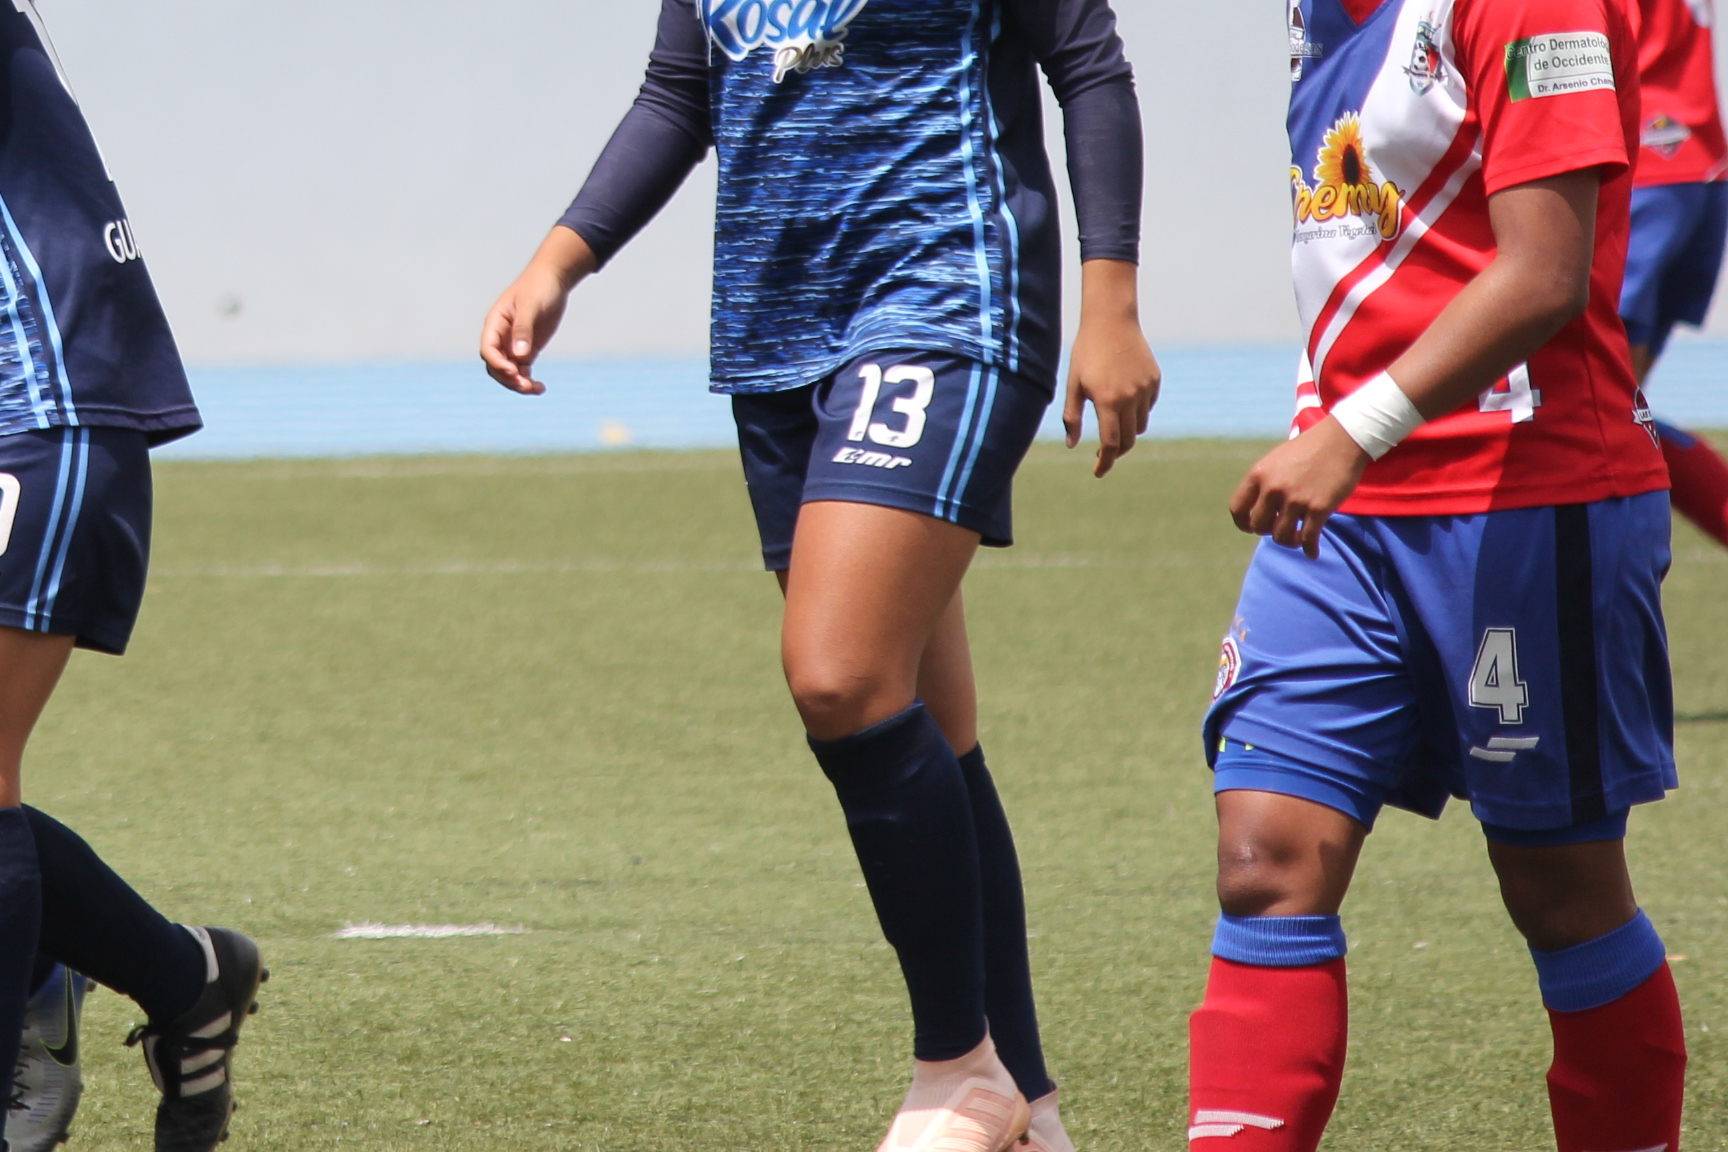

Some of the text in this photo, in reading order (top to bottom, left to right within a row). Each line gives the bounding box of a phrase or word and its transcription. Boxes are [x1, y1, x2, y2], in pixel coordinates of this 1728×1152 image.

[1534, 58, 1549, 71] de
[847, 363, 936, 448] 13
[1469, 627, 1529, 725] 4
